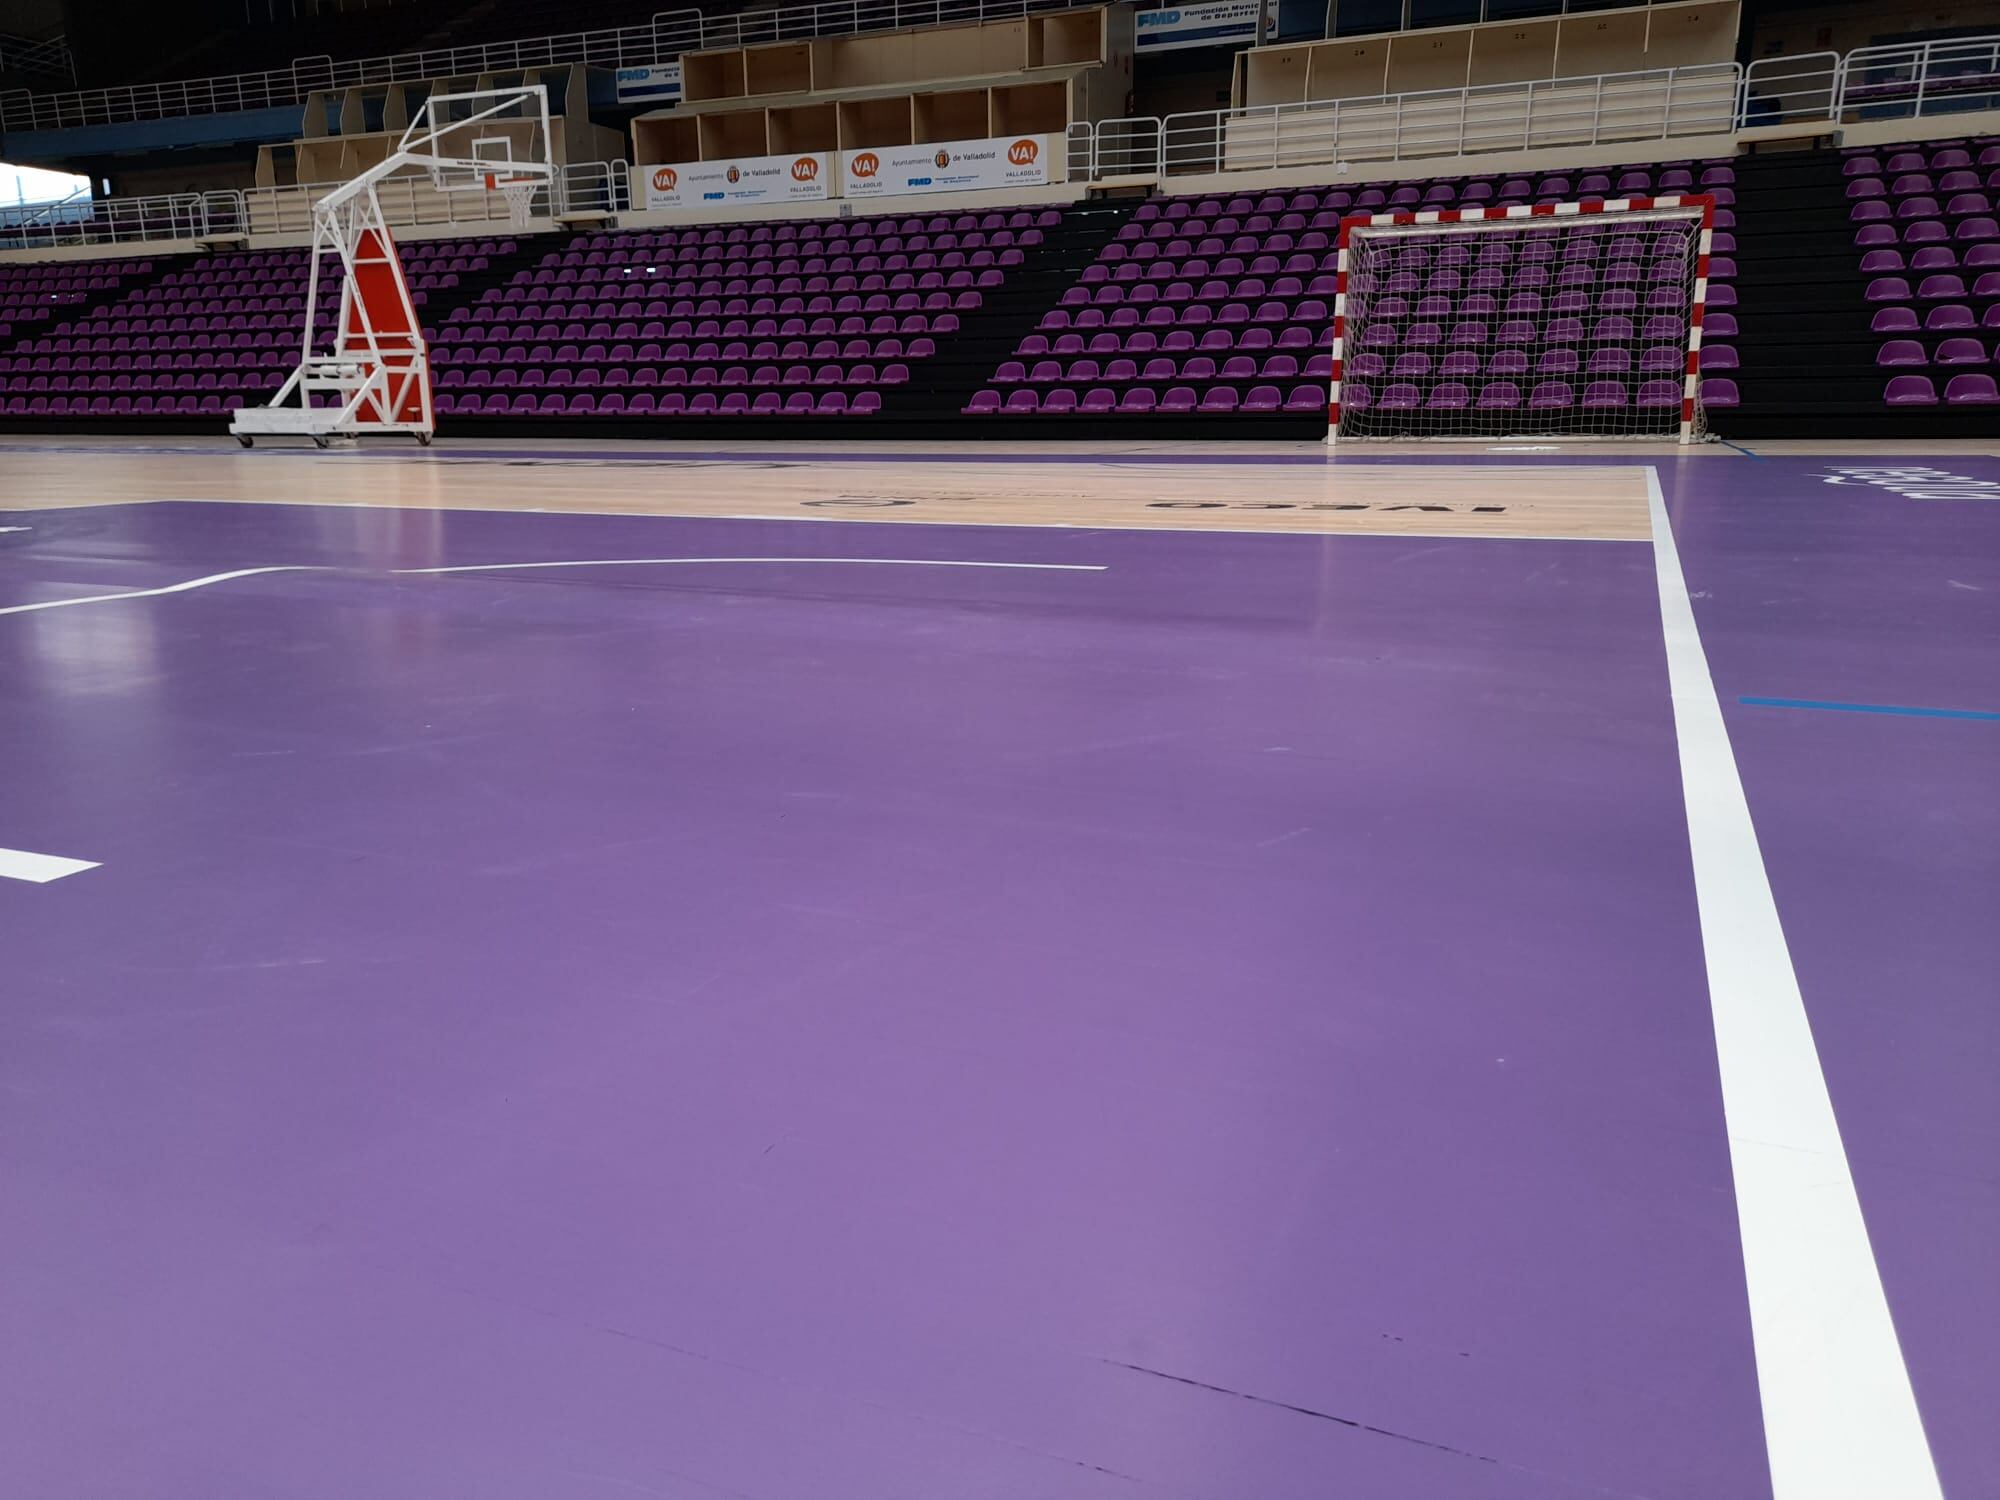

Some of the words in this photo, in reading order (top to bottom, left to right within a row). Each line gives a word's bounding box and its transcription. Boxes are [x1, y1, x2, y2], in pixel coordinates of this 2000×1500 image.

[1138, 10, 1181, 27] FMD
[618, 70, 650, 81] FMD
[1011, 144, 1034, 161] VA!
[854, 158, 876, 173] VA!
[892, 158, 932, 167] Ayuntamiento
[962, 152, 996, 160] Valladolid
[751, 168, 781, 176] Valladolid
[793, 162, 814, 177] VA!
[908, 178, 932, 186] FMD
[703, 192, 724, 200] FMD
[1145, 503, 1506, 512] IVECO
